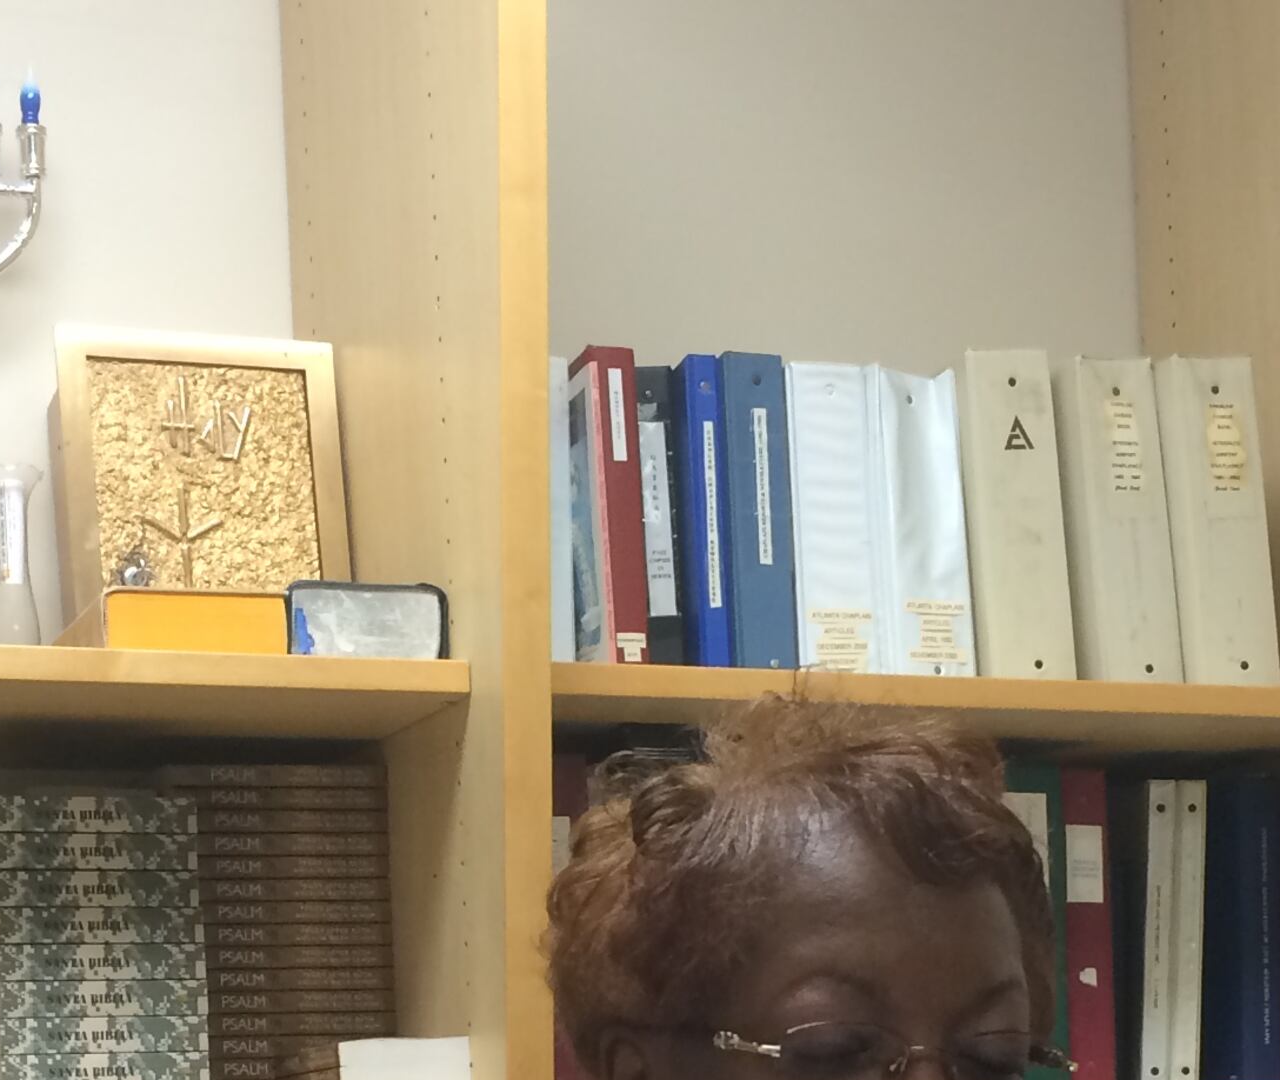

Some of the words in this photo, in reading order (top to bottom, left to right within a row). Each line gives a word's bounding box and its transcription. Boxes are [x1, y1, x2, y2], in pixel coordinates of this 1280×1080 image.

[208, 768, 257, 782] PSALM
[211, 791, 258, 804] PSALM
[215, 815, 261, 828] PSALM
[214, 837, 261, 851] PSALM
[216, 860, 262, 874] PSALM
[216, 883, 262, 897] PSALM
[218, 906, 263, 919] PSALM
[218, 929, 264, 942] PSALM
[88, 957, 131, 968] BIBLIA
[219, 951, 264, 964] PSALM
[220, 973, 265, 987] PSALM
[47, 993, 87, 1004] SANTA
[90, 993, 132, 1004] BIBLIA
[221, 995, 266, 1009] PSALM
[222, 1018, 267, 1031] PSALM
[48, 1031, 88, 1041] SANTA
[91, 1031, 134, 1041] BIBLIA
[223, 1040, 268, 1053] PSALM
[49, 1067, 89, 1078] SANTA
[92, 1067, 135, 1078] BIBLIA
[223, 1062, 269, 1075] PSALM
